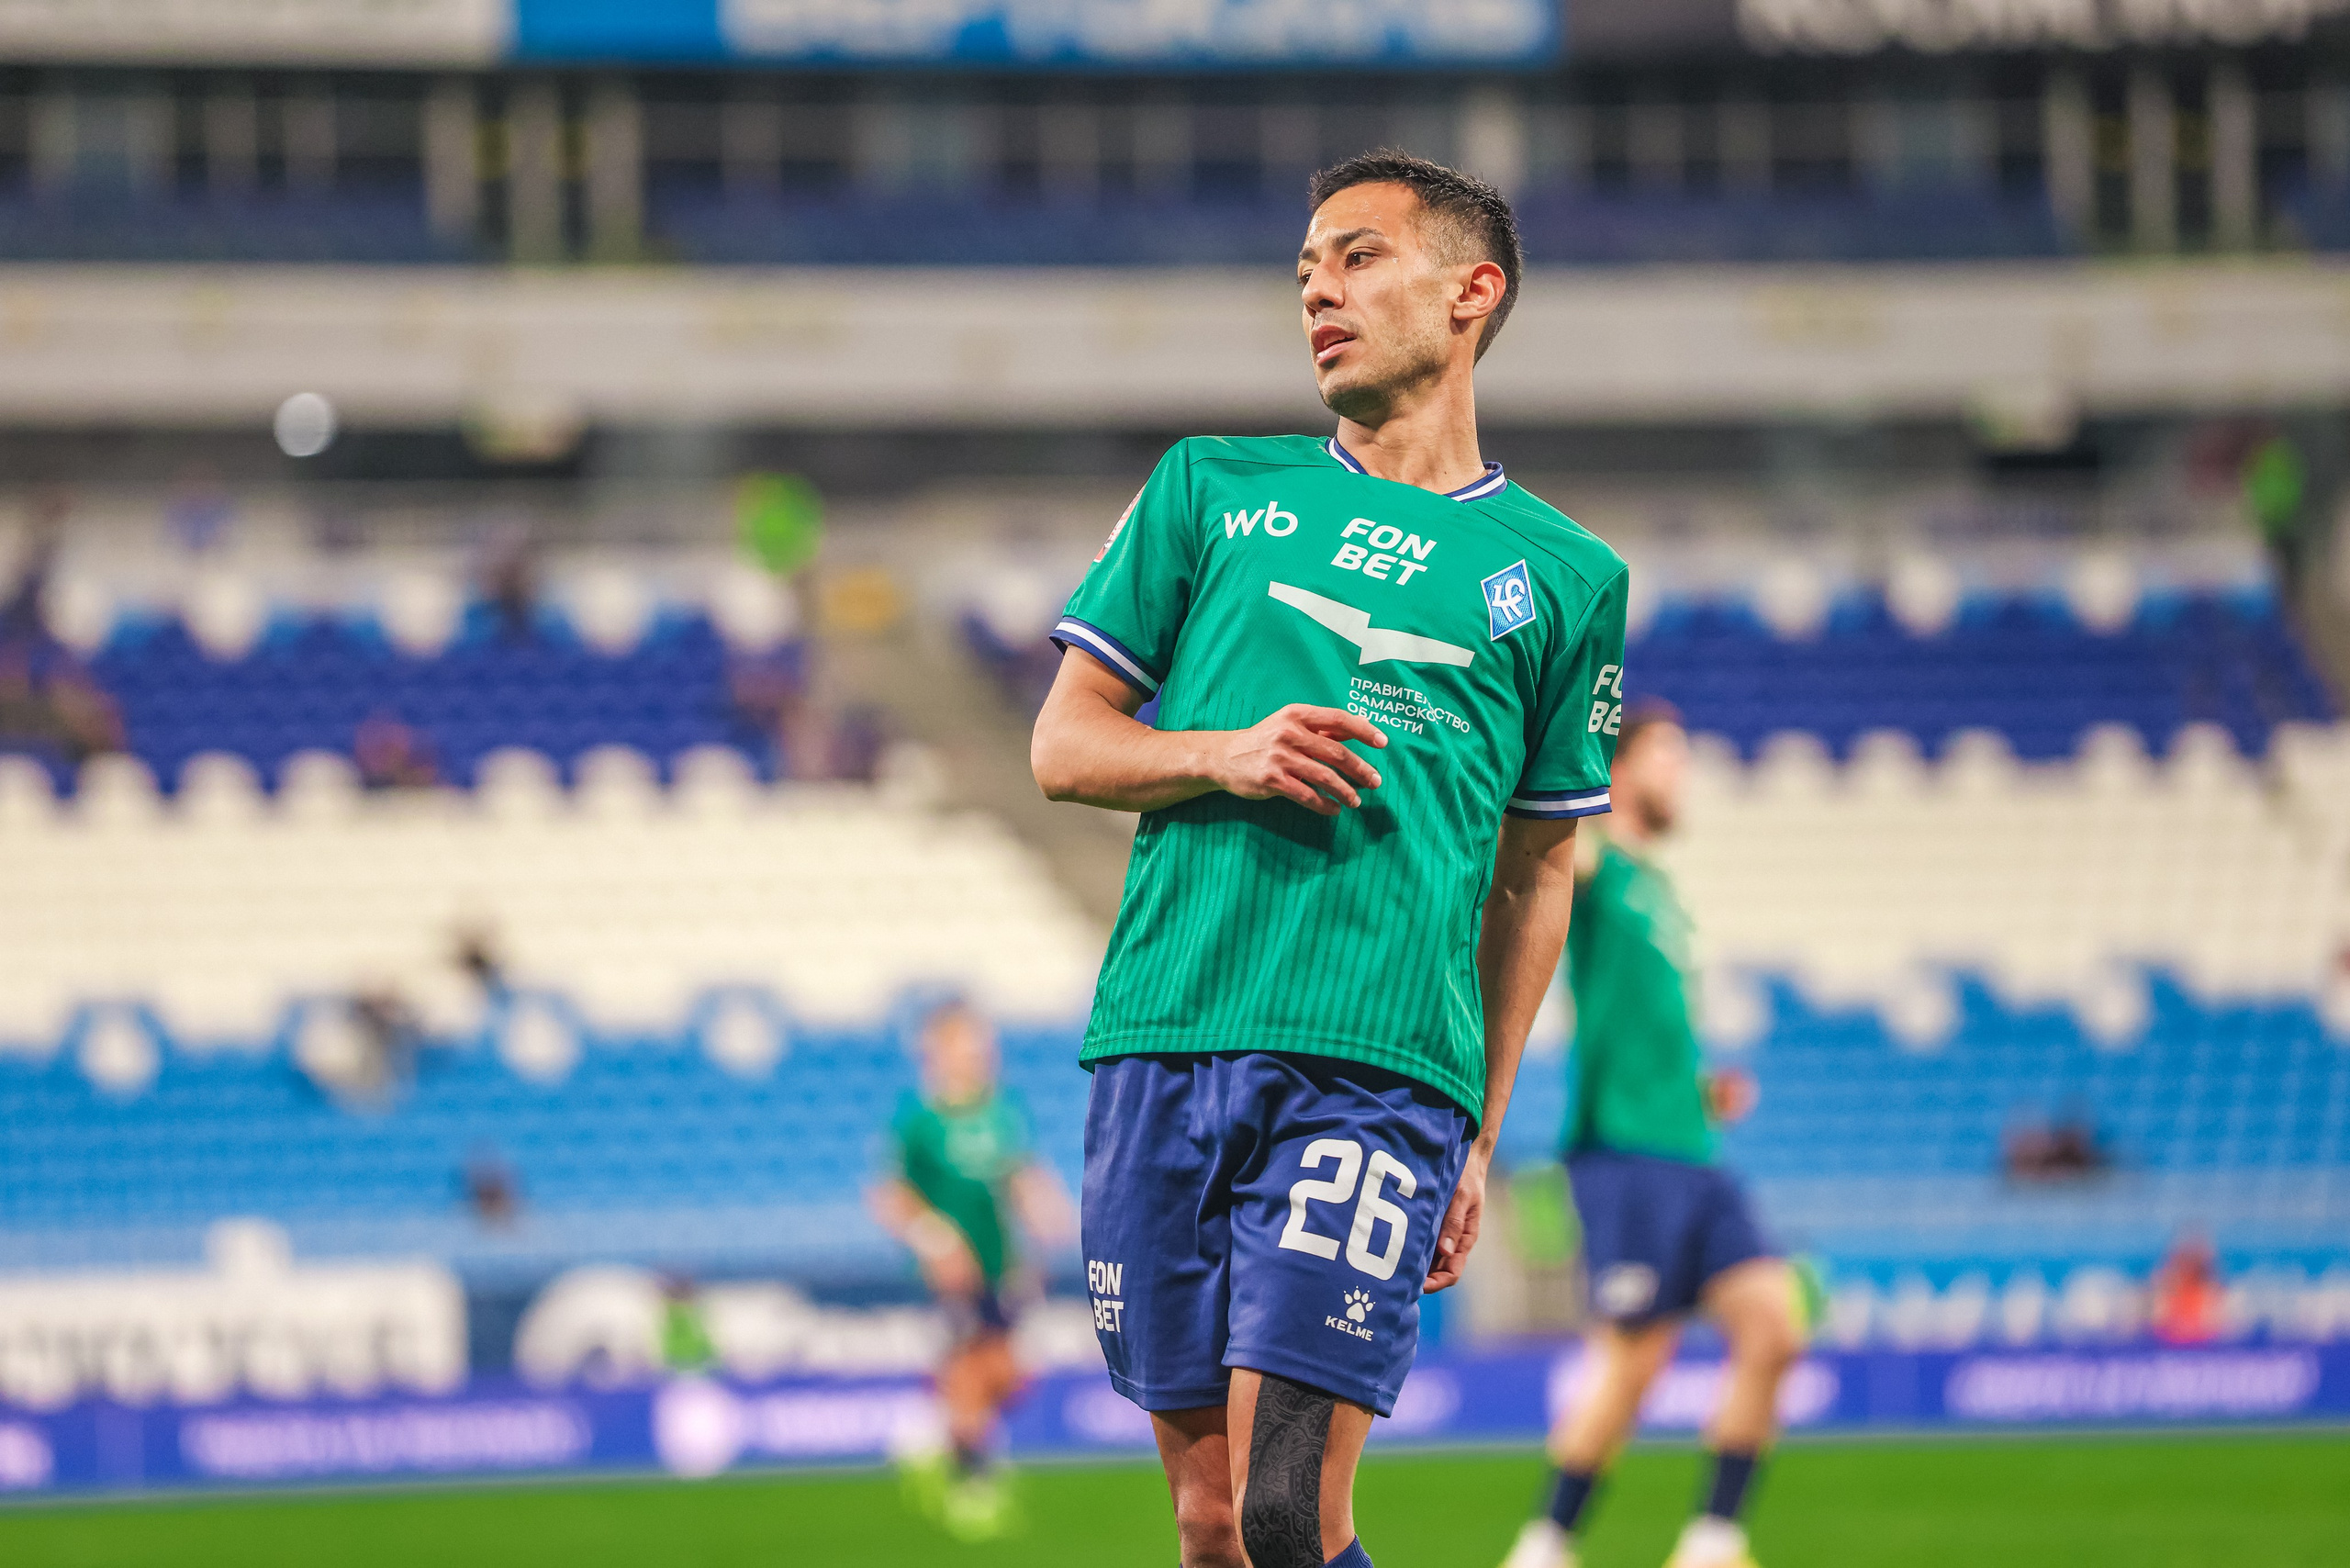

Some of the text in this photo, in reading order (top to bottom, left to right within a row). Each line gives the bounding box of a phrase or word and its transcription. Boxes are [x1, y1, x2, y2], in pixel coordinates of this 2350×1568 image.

[1224, 501, 1298, 539] wb
[1340, 518, 1438, 561] FON
[1330, 543, 1428, 586] BET
[1347, 701, 1424, 735] ОБЛАСТИ
[1348, 689, 1438, 723] САМАРСКО
[1278, 1138, 1417, 1281] 26
[1088, 1260, 1124, 1296] FON
[1093, 1296, 1125, 1333] BET
[1325, 1315, 1374, 1342] KELME
